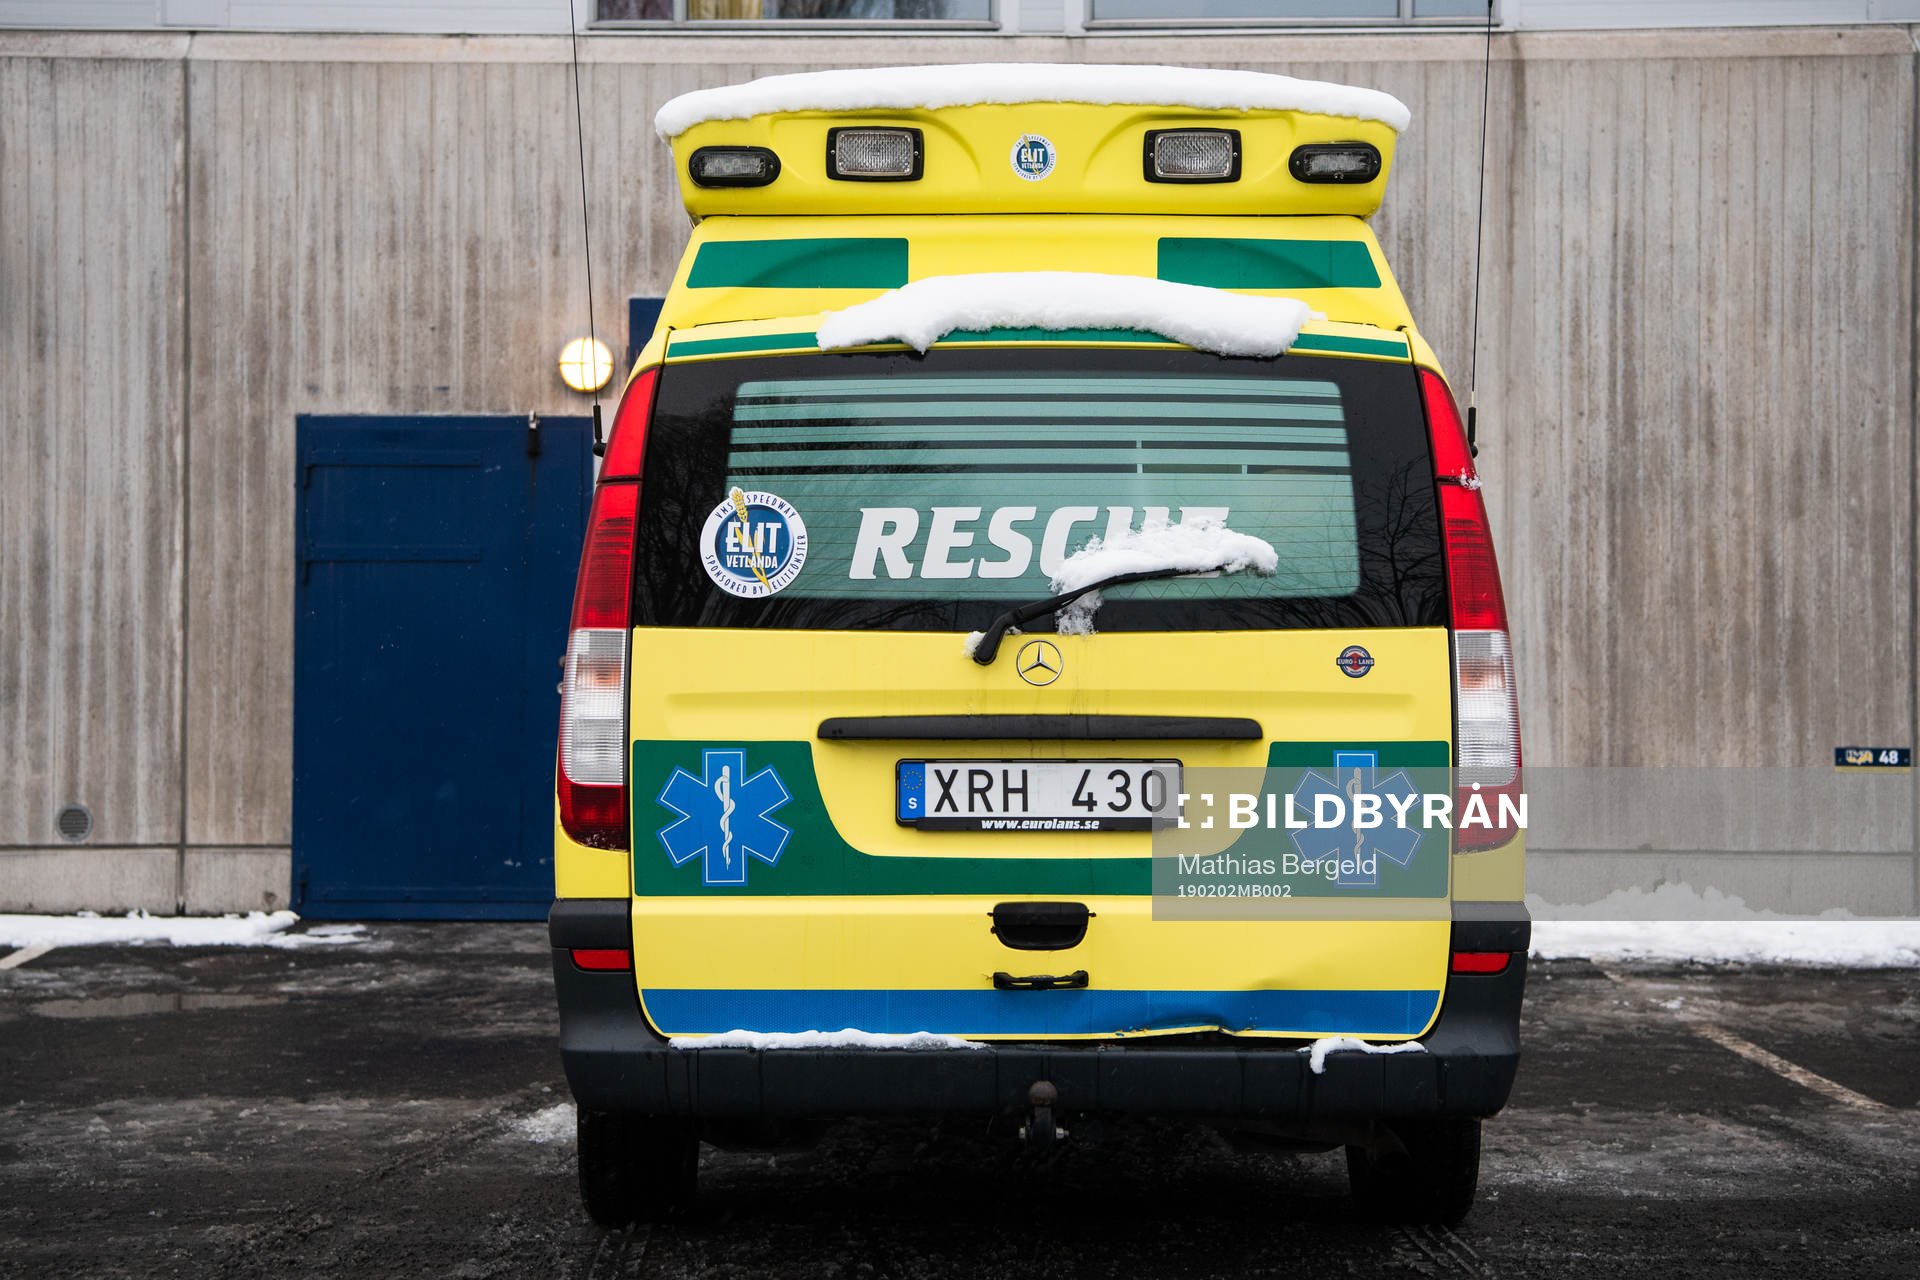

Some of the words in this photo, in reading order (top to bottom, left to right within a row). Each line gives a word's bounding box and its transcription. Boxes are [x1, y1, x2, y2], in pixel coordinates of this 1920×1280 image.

[1021, 148, 1045, 162] ELIT
[714, 501, 735, 520] VMS
[746, 494, 798, 519] SPEEDWAY
[725, 521, 782, 554] ELIT
[726, 554, 779, 569] VETLANDA
[705, 554, 748, 594] SPONSORED
[752, 585, 764, 595] BY
[1879, 750, 1899, 765] 48
[934, 769, 1028, 813] XRH
[1072, 769, 1167, 813] 430
[907, 797, 918, 809] S
[981, 817, 1100, 830] www.eurolans.se
